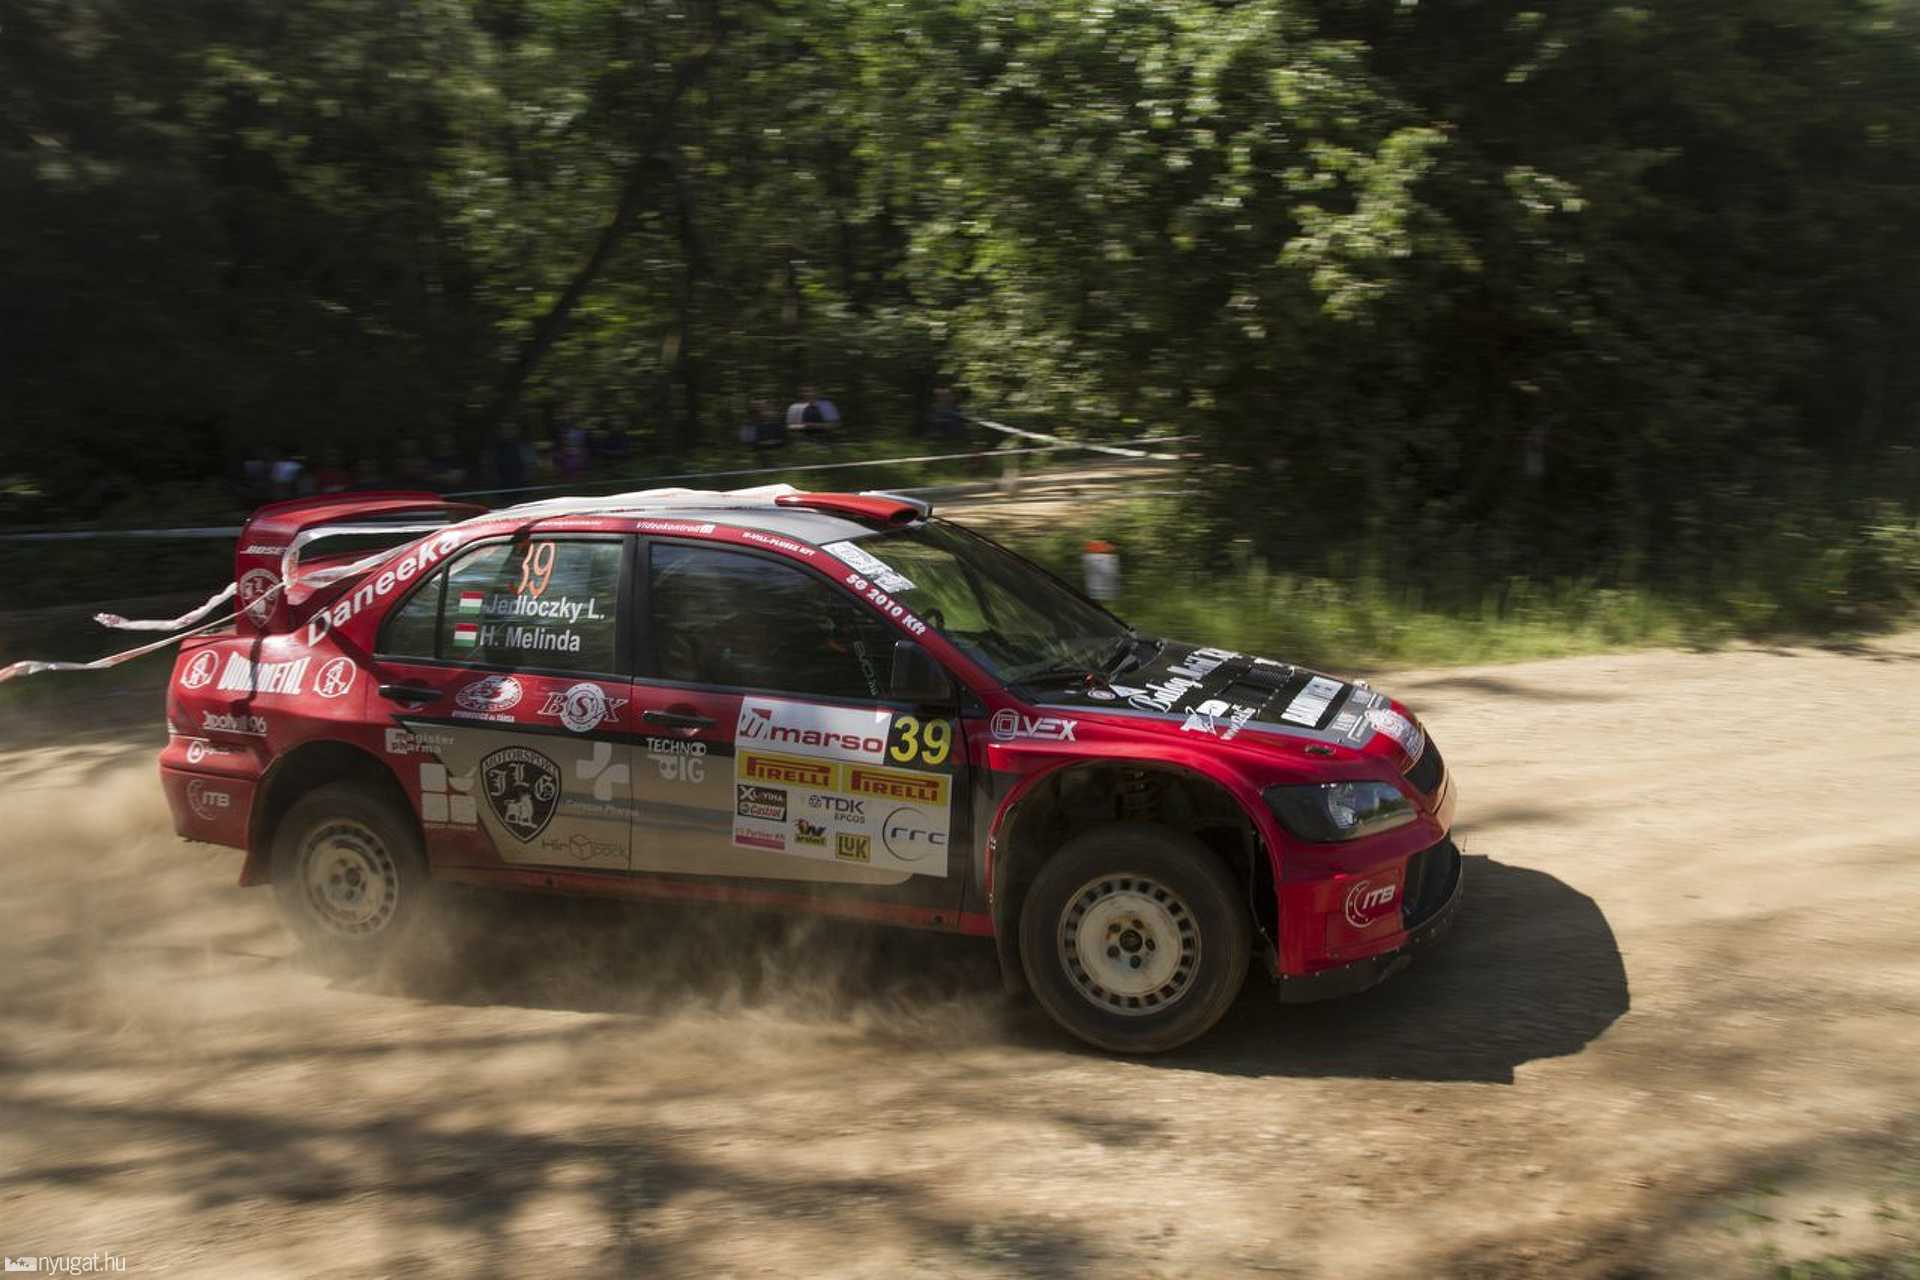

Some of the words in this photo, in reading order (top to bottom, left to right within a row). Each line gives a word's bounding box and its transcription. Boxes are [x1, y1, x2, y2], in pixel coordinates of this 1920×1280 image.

[308, 531, 462, 648] Daneeka
[865, 586, 902, 616] 2010
[588, 598, 605, 619] L.
[480, 624, 499, 647] H.
[505, 627, 581, 652] Melinda
[770, 725, 884, 754] marso
[890, 715, 951, 765] 39
[746, 756, 832, 787] PIRELLI
[851, 770, 940, 802] PIRELLI
[821, 795, 865, 815] TDK
[1363, 886, 1396, 910] ITB
